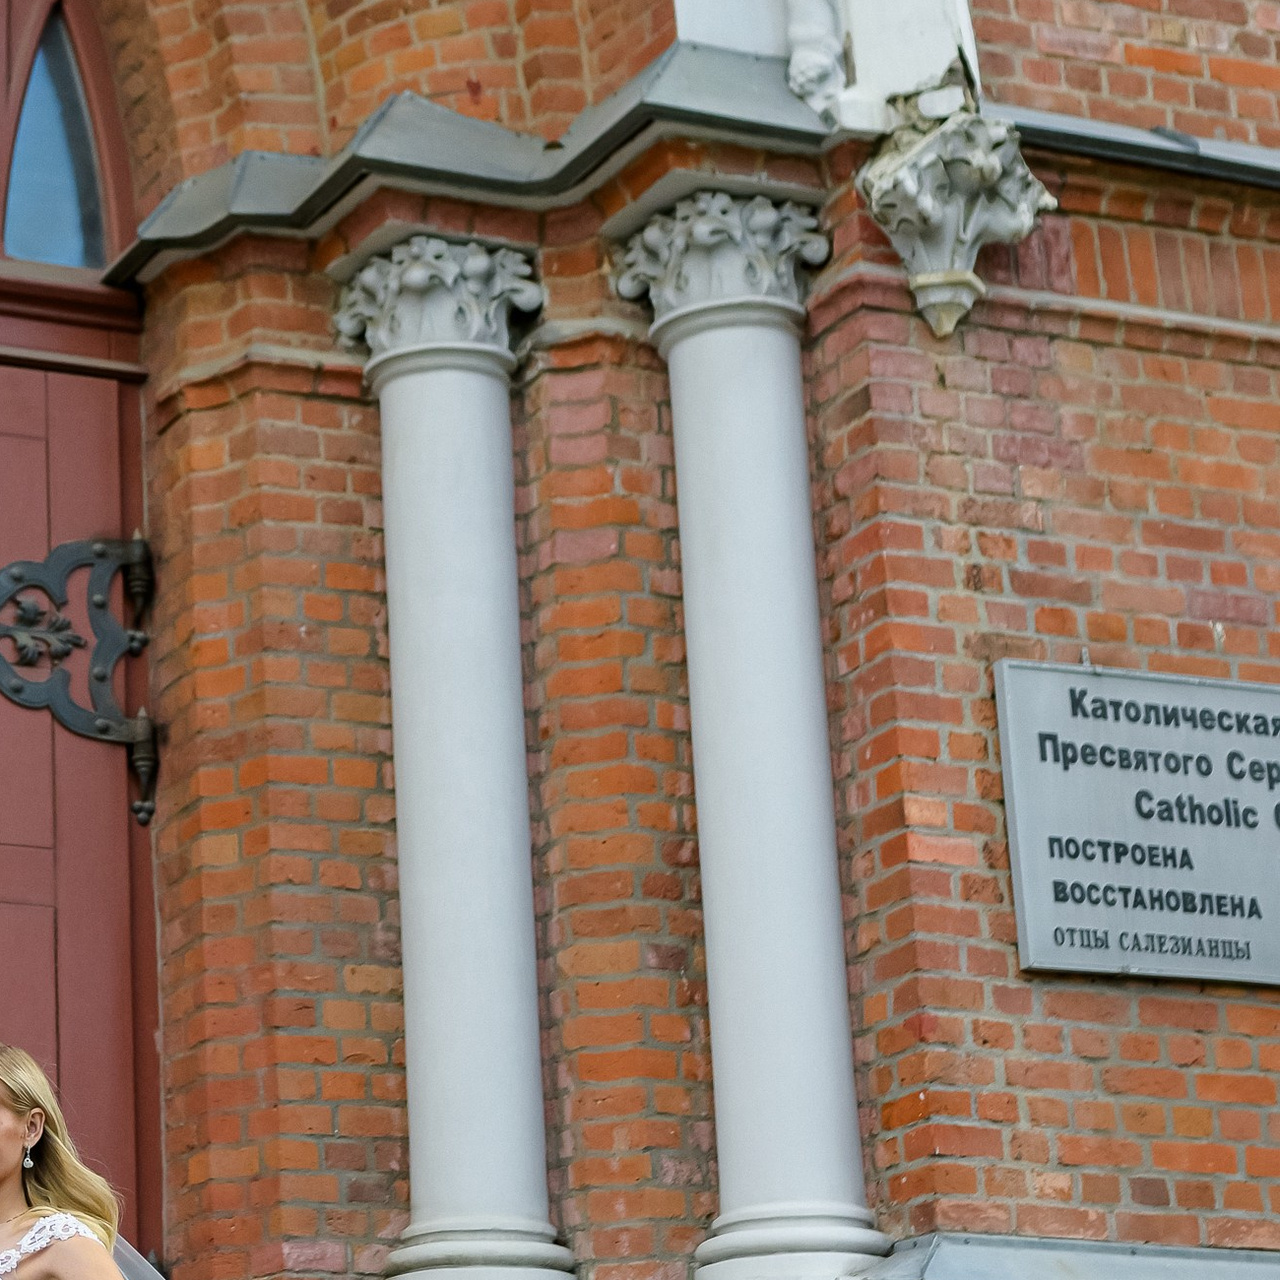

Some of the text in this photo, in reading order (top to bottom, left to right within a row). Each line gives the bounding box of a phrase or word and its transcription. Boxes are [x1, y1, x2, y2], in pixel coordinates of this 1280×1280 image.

[1038, 731, 1214, 776] Пресвятого
[1135, 789, 1259, 829] Catholic
[1048, 836, 1194, 870] ПОСТРОЕНА
[1052, 880, 1263, 920] ВОССТАНОВЛЕНА
[1053, 926, 1251, 961] ОТЦЫ САЛЕЗИАНЦЫ
